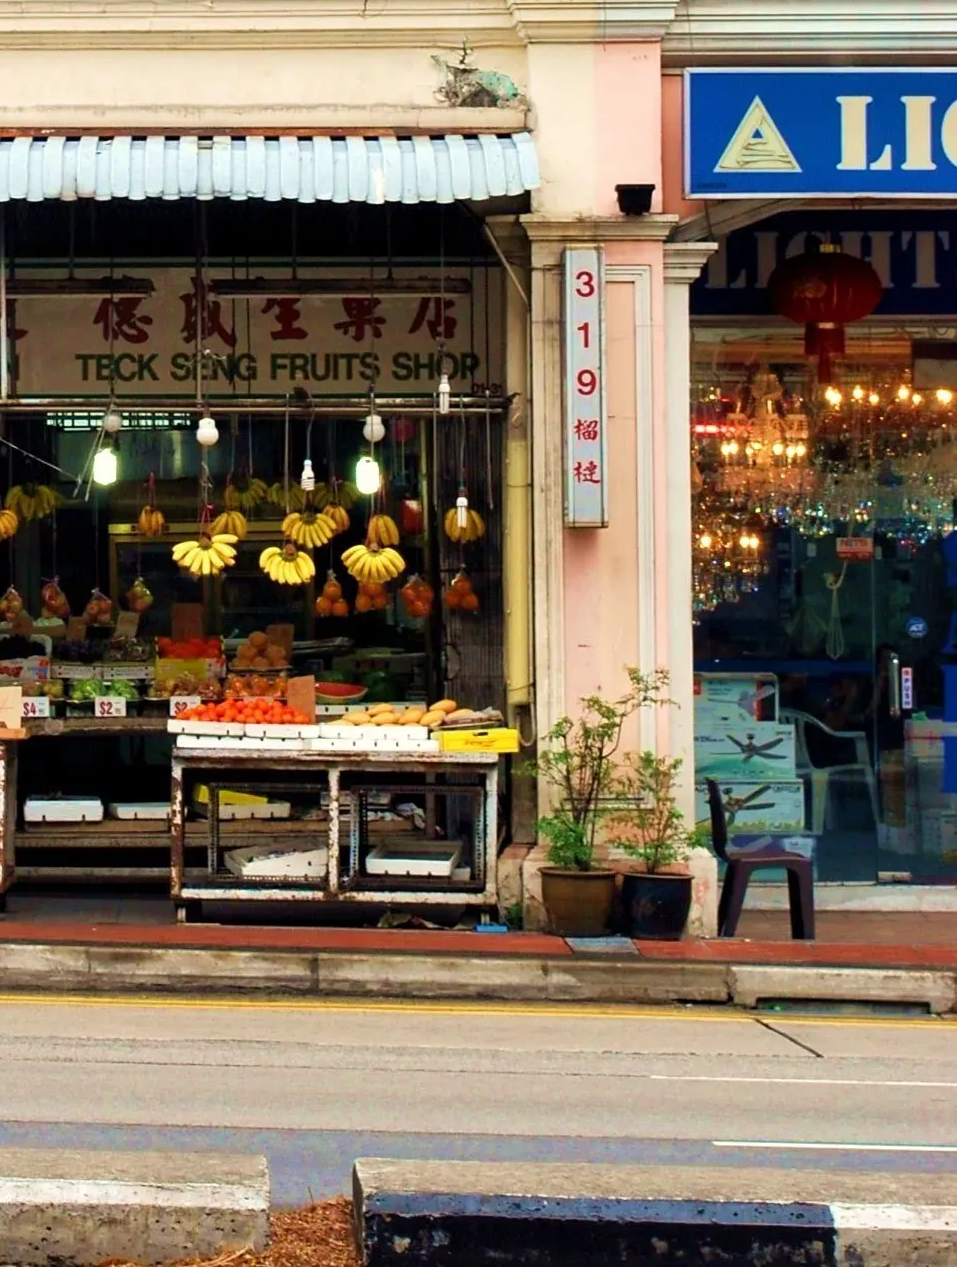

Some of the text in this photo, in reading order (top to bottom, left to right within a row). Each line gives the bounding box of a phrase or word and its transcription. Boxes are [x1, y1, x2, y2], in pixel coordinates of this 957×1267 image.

[836, 95, 957, 171] LI
[75, 353, 160, 382] TECK
[170, 352, 258, 382] SENG
[270, 352, 381, 382] FRUITS
[391, 352, 481, 382] SHOP
[23, 701, 37, 716] $4
[99, 700, 113, 715] $2
